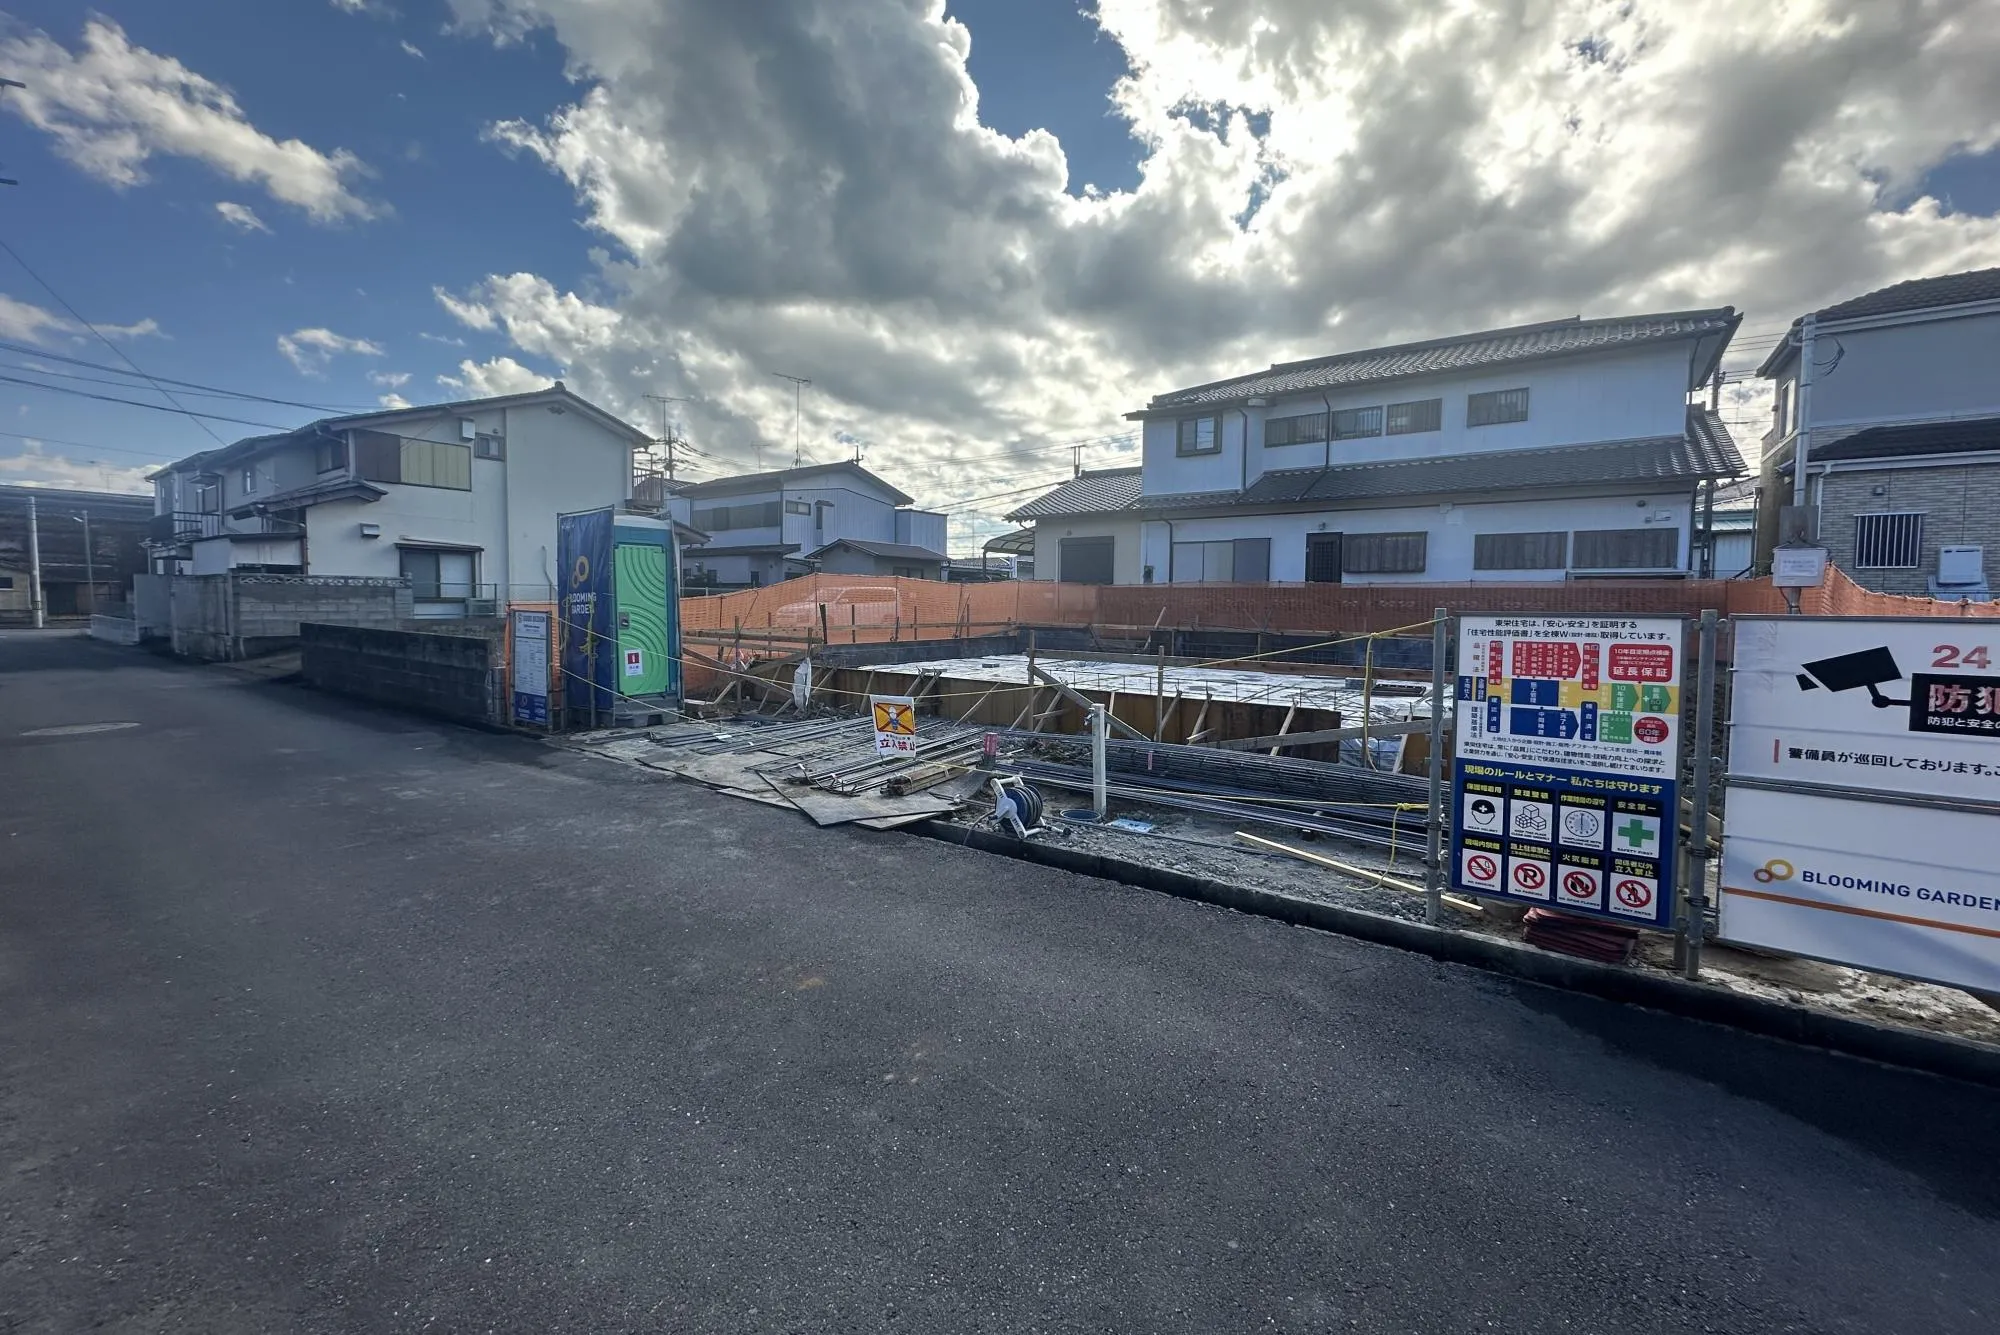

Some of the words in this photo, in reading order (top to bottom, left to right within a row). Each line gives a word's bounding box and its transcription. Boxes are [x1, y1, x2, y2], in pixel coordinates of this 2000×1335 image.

[1495, 619, 1638, 629] 東栄住宅は、「安心・安全」を証明する
[1931, 645, 1992, 669] 24
[1613, 666, 1668, 677] 延長保証
[879, 738, 916, 751] 立入禁止
[1464, 764, 1568, 782] 現場のルールとマナー
[1570, 776, 1663, 795] 私たちは守ります
[1616, 801, 1657, 812] 安全第一
[1562, 854, 1600, 866] 火気厳禁
[1614, 858, 1654, 870] 関係者以外
[1614, 866, 1654, 878] 立入禁止
[1802, 870, 1910, 897] BLOOMING
